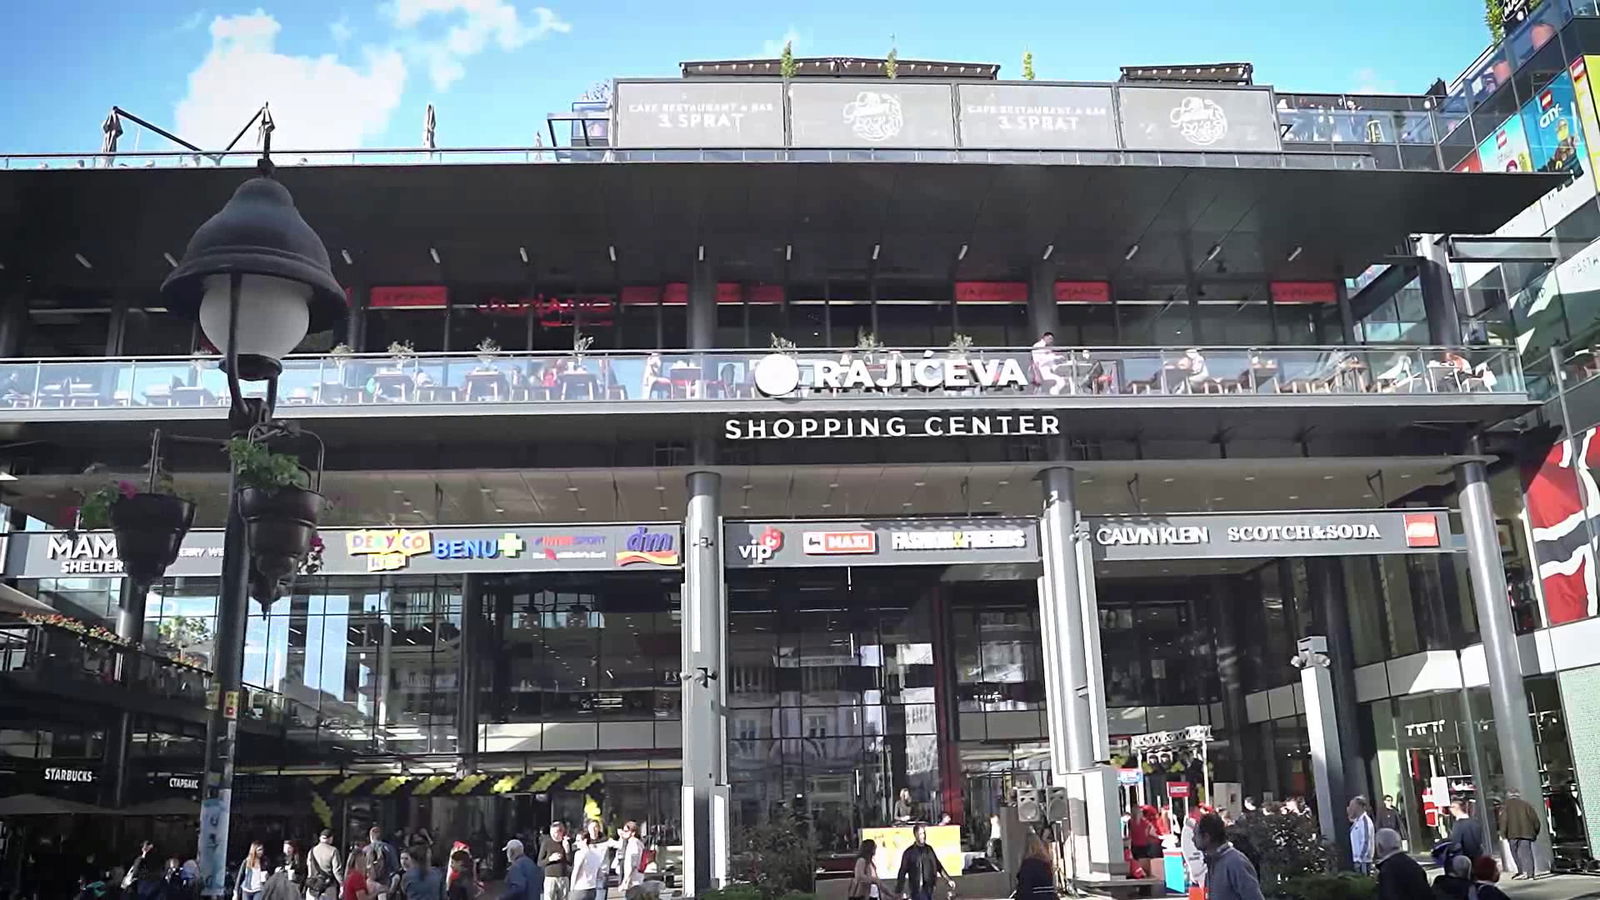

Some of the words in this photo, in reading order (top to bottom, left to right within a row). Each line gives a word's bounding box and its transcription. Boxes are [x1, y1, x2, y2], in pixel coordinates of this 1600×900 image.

[662, 103, 736, 113] RESTAURANT
[678, 113, 745, 131] SPRAT
[1016, 116, 1080, 130] SPRAT
[814, 350, 1029, 389] RAJIĆEVA
[725, 417, 906, 440] SHOPPING
[924, 415, 1060, 437] CENTER
[627, 527, 673, 553] dm
[828, 535, 869, 548] MAXI
[1096, 526, 1160, 545] CALVIN
[1160, 526, 1210, 544] KLEIN
[1227, 523, 1382, 542] SCOTCH&SODA
[47, 535, 118, 559] MAM
[433, 537, 500, 559] BENU
[738, 539, 773, 563] vip
[60, 560, 124, 574] SHELTER
[44, 767, 93, 783] STARBUCKS
